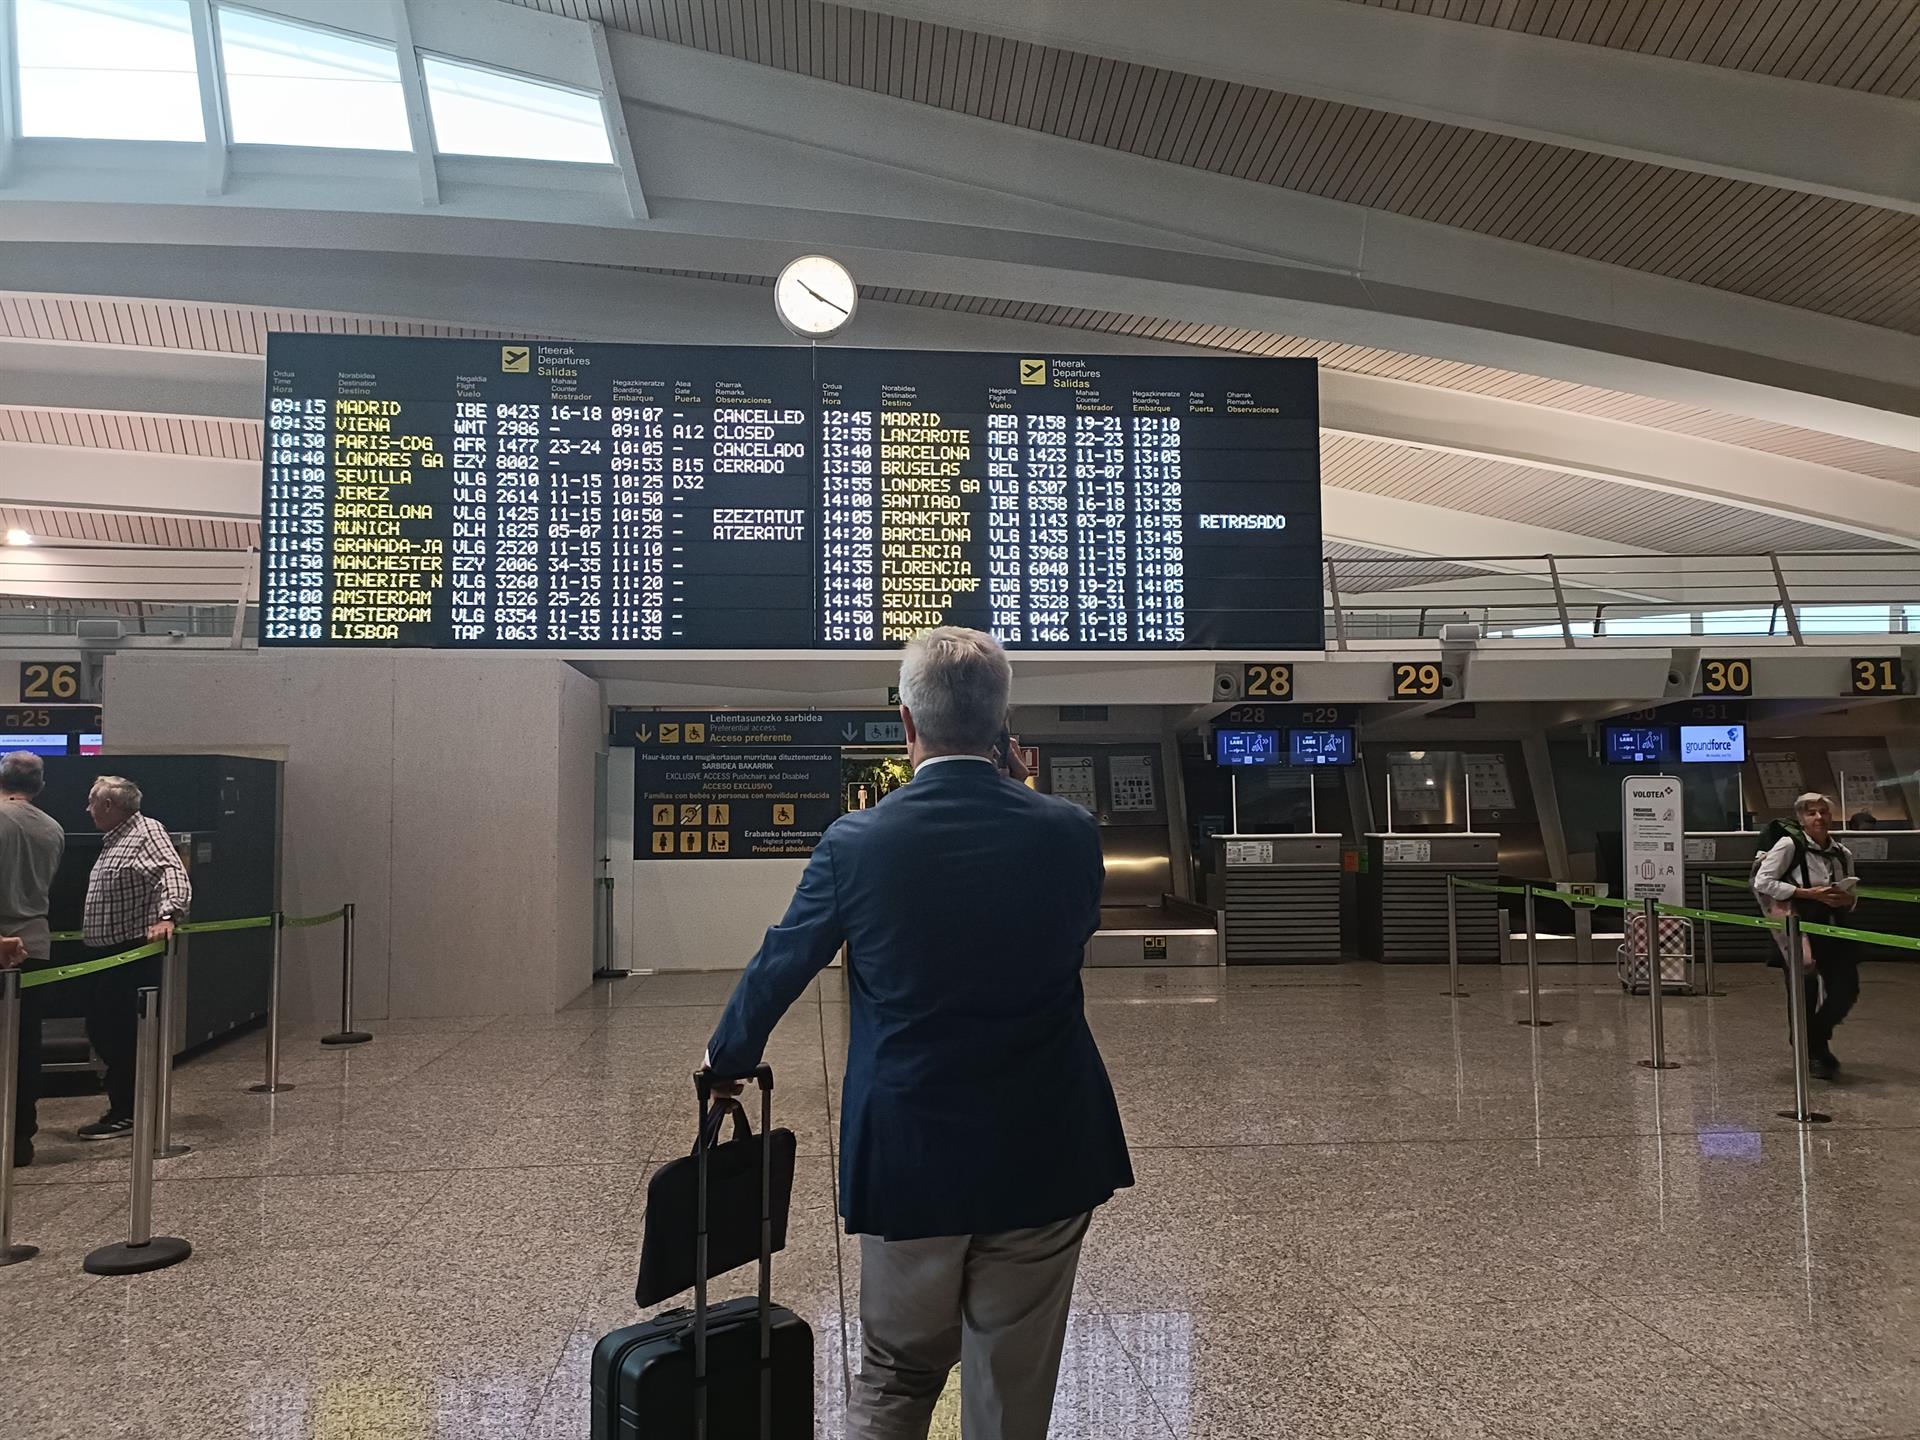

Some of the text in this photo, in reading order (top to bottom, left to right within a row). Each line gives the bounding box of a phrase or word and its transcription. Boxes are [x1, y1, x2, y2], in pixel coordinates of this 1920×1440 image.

[538, 346, 574, 355] Irteerak
[538, 356, 590, 366] Departures
[1052, 360, 1085, 368] Irteerak
[273, 370, 295, 378] Ordua
[538, 367, 577, 376] Salidas
[1053, 369, 1100, 378] Departures
[456, 375, 487, 383] Hegaldia
[1054, 379, 1090, 388] Salidas
[339, 387, 370, 395] Destino
[457, 390, 481, 398] Vuelo
[613, 387, 642, 395] Boarding
[675, 395, 700, 403] Puerta
[271, 399, 805, 424] 09:15 MADRID IBE 0423 16-18 09:07 CANCELLED
[1133, 405, 1171, 413] Embarque
[823, 411, 1180, 431] 12:45 MADRID AEA 7158 19-21 12:10
[270, 417, 774, 440] 09:35 VIENA WMT 2986 09:16 A12 CLOSED
[272, 434, 804, 457] 10:30 PARIS-CDG AFR 1477 23-24 10:05 CANCELADO
[271, 451, 784, 474] 10:40 LONDRES GA EZY 8002 09:53 B15 CERRADO
[823, 478, 1181, 496] 13:55 LONDRES GA VLG 6307 11-15 13:20
[270, 503, 805, 523] 11:25 BARCELONA VLG 1425 11-15 10:50 EZEZTATUT
[824, 511, 1285, 529] 14:05 FRANKFURT DLH 1143 03-07 16:55 RETRASADO
[269, 520, 804, 540] 11:35 MUNICH DLH 1825 05-07 11:25 ATZERATUT
[824, 561, 1183, 576] 14:35 FLORENCIA VLG 6040 11-15 14:00
[25, 665, 77, 697] 26
[1248, 666, 1290, 695] 28
[1397, 665, 1440, 694] 29
[1706, 662, 1749, 691] 30
[1856, 661, 1896, 690] 31
[22, 711, 50, 727] 25
[1245, 708, 1265, 722] 28
[1316, 708, 1338, 723] 29
[1708, 705, 1727, 719] 31
[745, 734, 792, 743] preferente
[1686, 740, 1731, 753] groundforce
